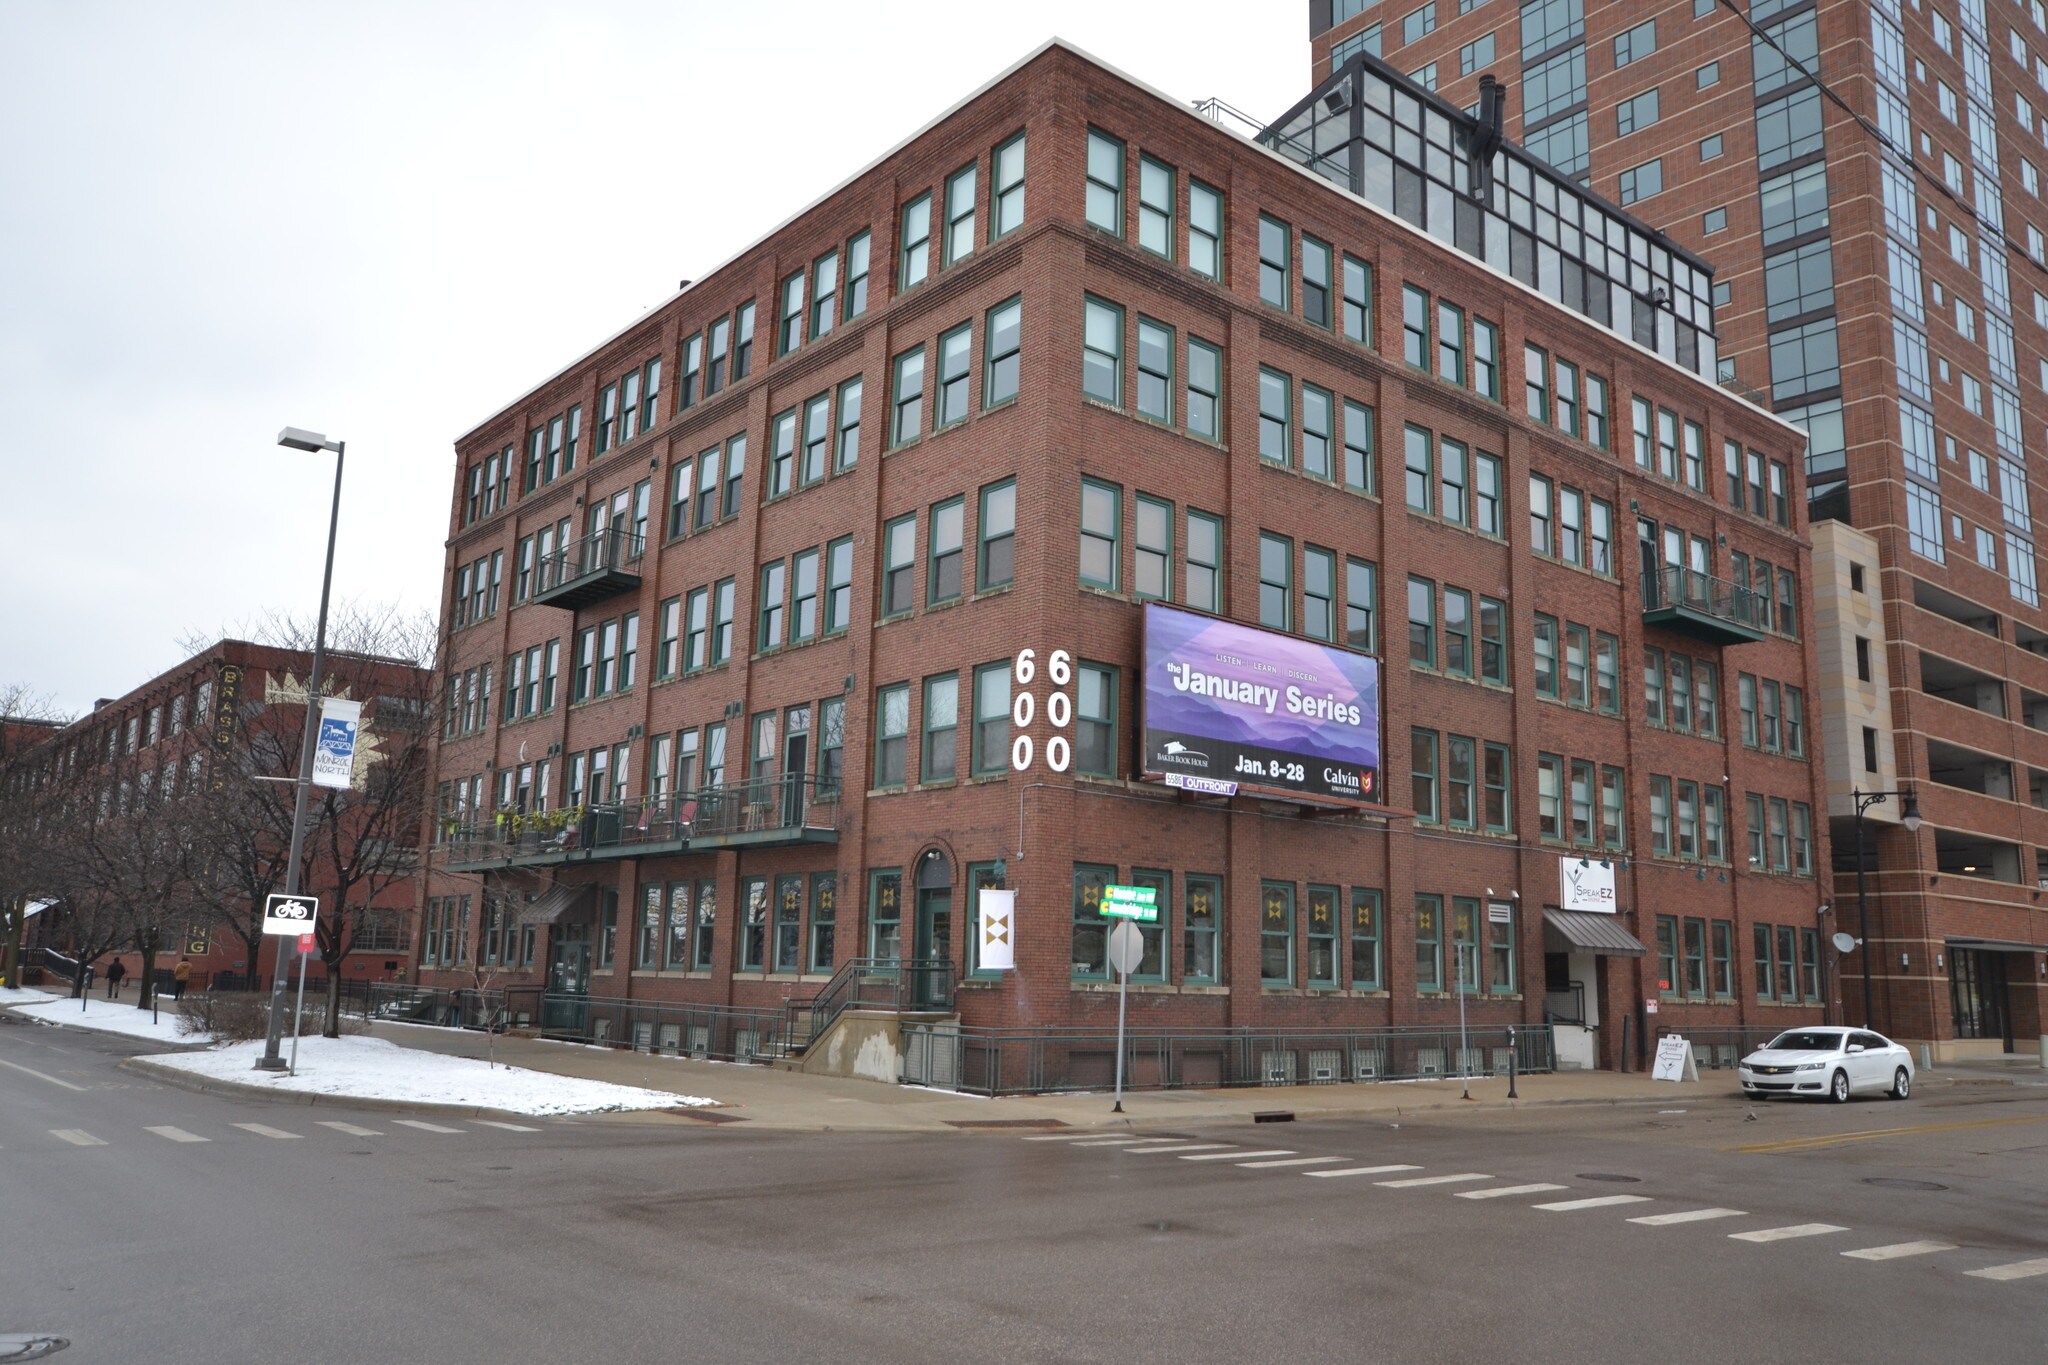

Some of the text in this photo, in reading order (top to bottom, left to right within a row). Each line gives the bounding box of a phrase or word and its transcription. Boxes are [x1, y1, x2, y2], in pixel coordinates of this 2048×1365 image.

[1216, 654, 1318, 683] LISTEN LEARN DISCERN
[1167, 662, 1361, 726] the January Series
[1012, 648, 1036, 772] 600
[1046, 649, 1071, 773] 600
[1157, 752, 1209, 768] BAKER BOOK HOUSE
[1235, 754, 1267, 776] Jan.
[1186, 777, 1232, 793] OUTFRONT
[1323, 767, 1359, 787] Calvin
[1331, 785, 1360, 795] UNIVERSITY
